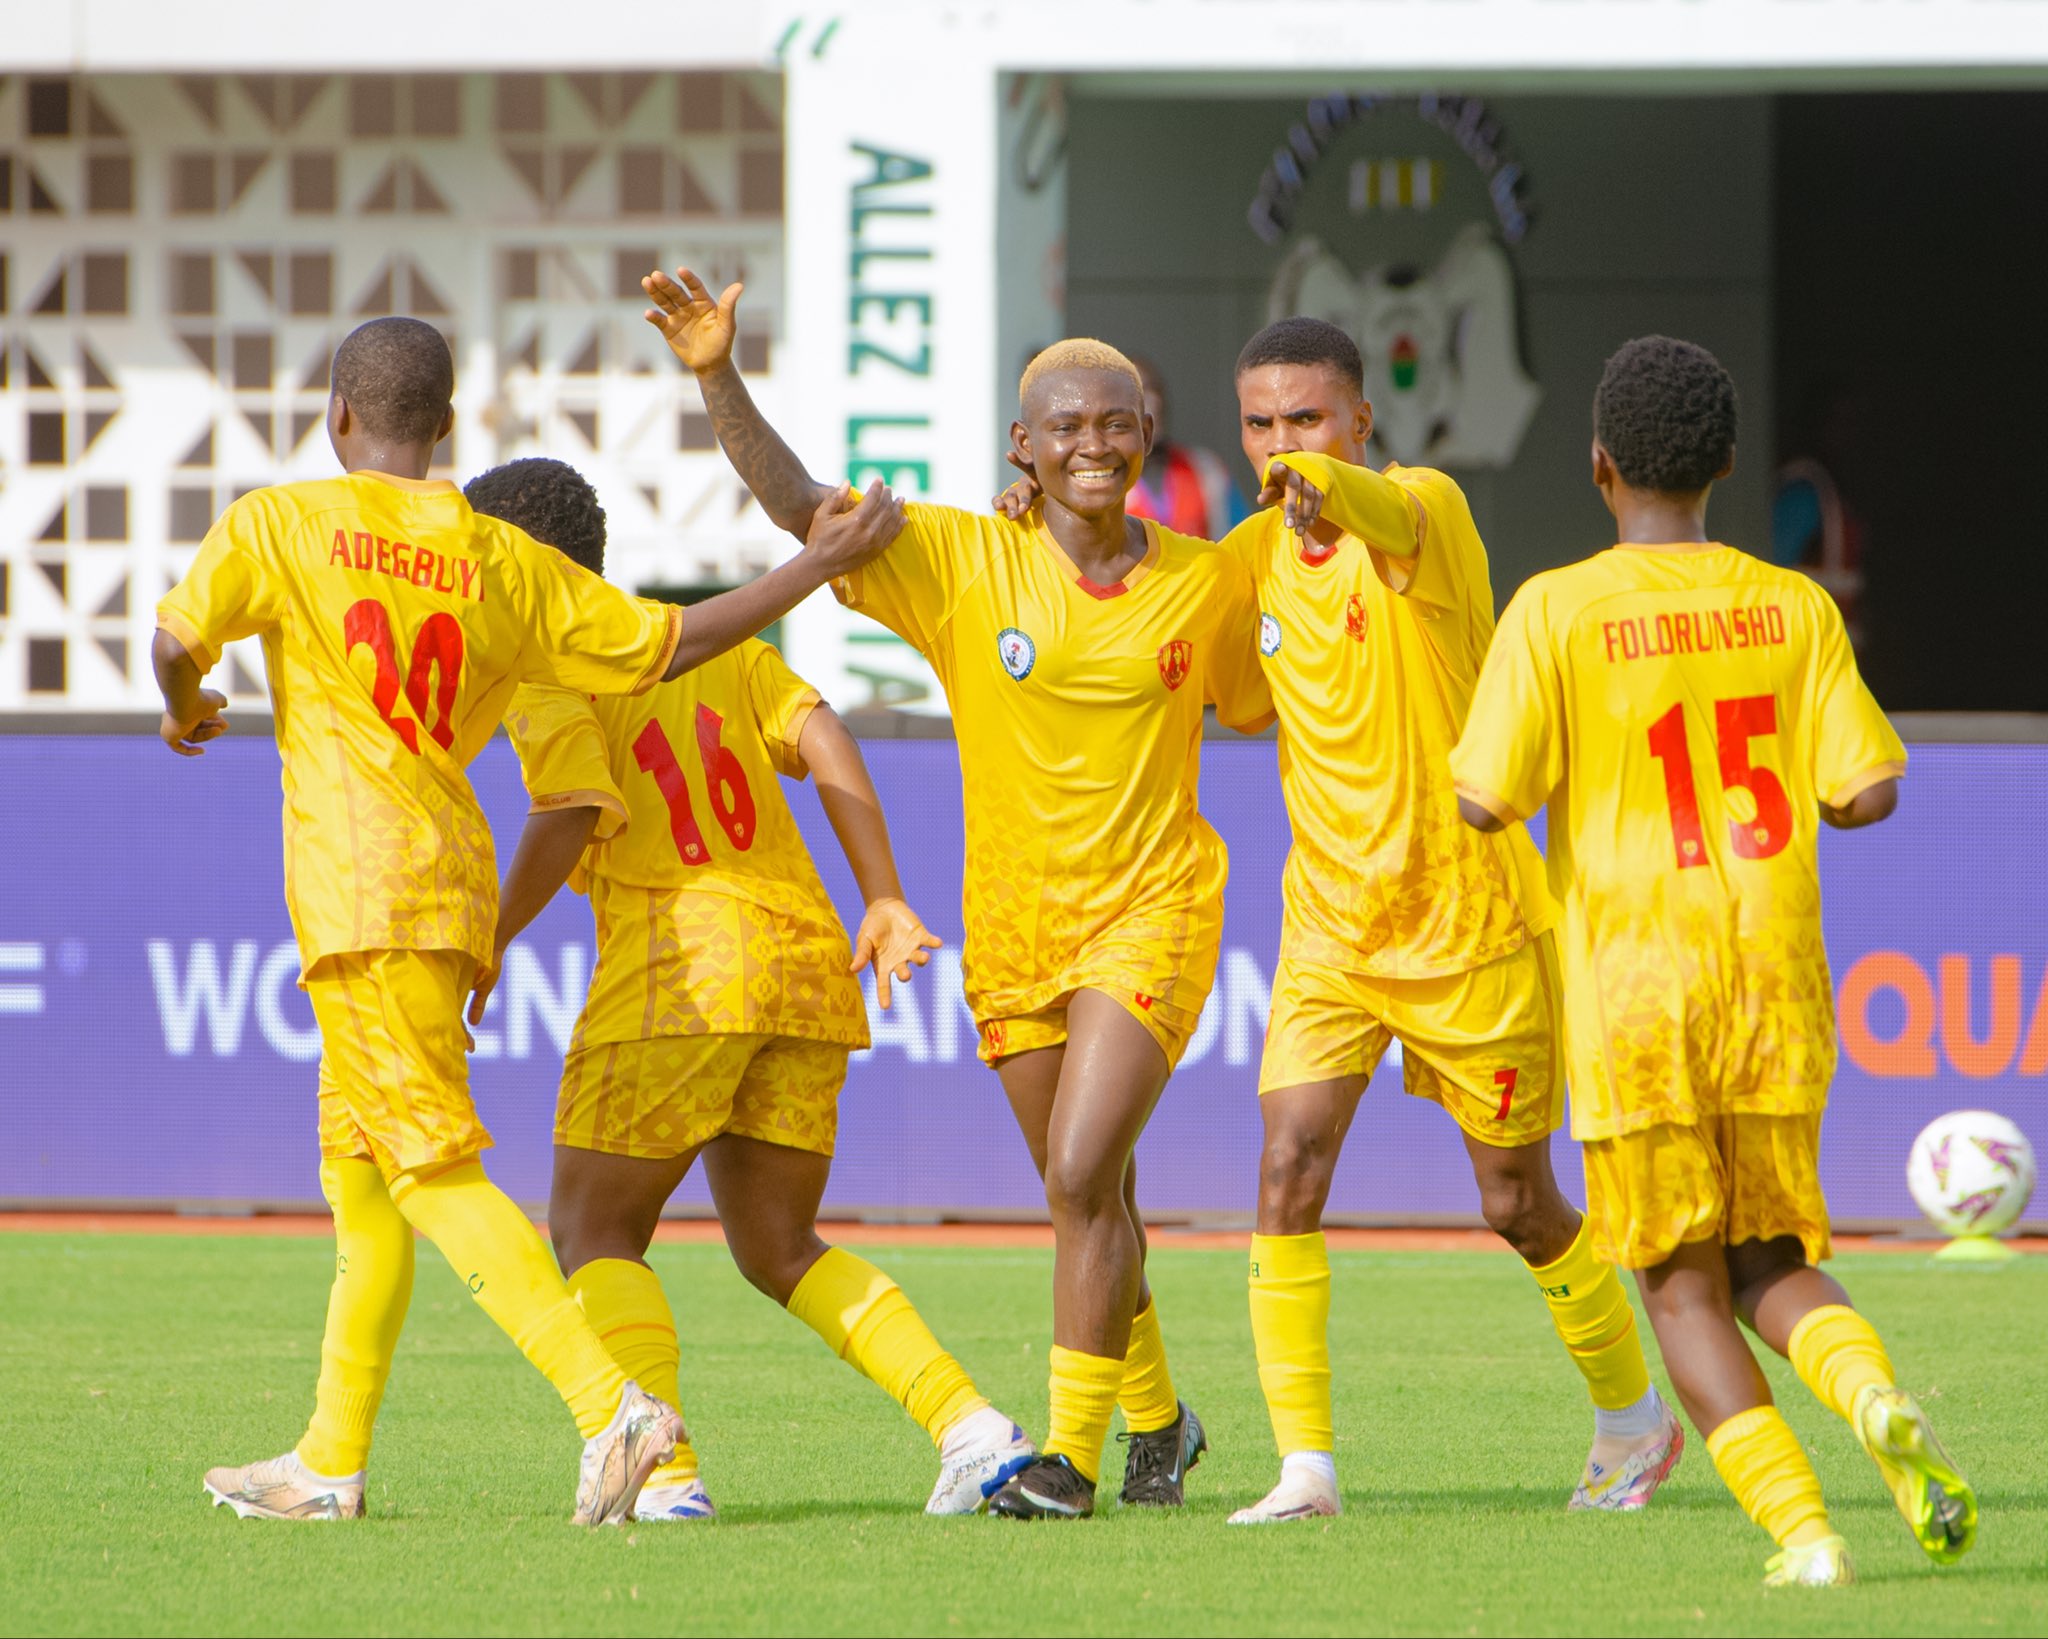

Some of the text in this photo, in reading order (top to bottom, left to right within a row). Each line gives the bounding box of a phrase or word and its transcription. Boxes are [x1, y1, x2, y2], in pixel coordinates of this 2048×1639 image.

[846, 139, 933, 495] ALLEZ LE
[343, 598, 464, 757] 20
[1602, 604, 1786, 663] FOLORUNSHO
[632, 700, 757, 867] 16
[1647, 694, 1794, 870] 15
[146, 938, 588, 1063] WON
[1494, 1066, 1519, 1121] 7
